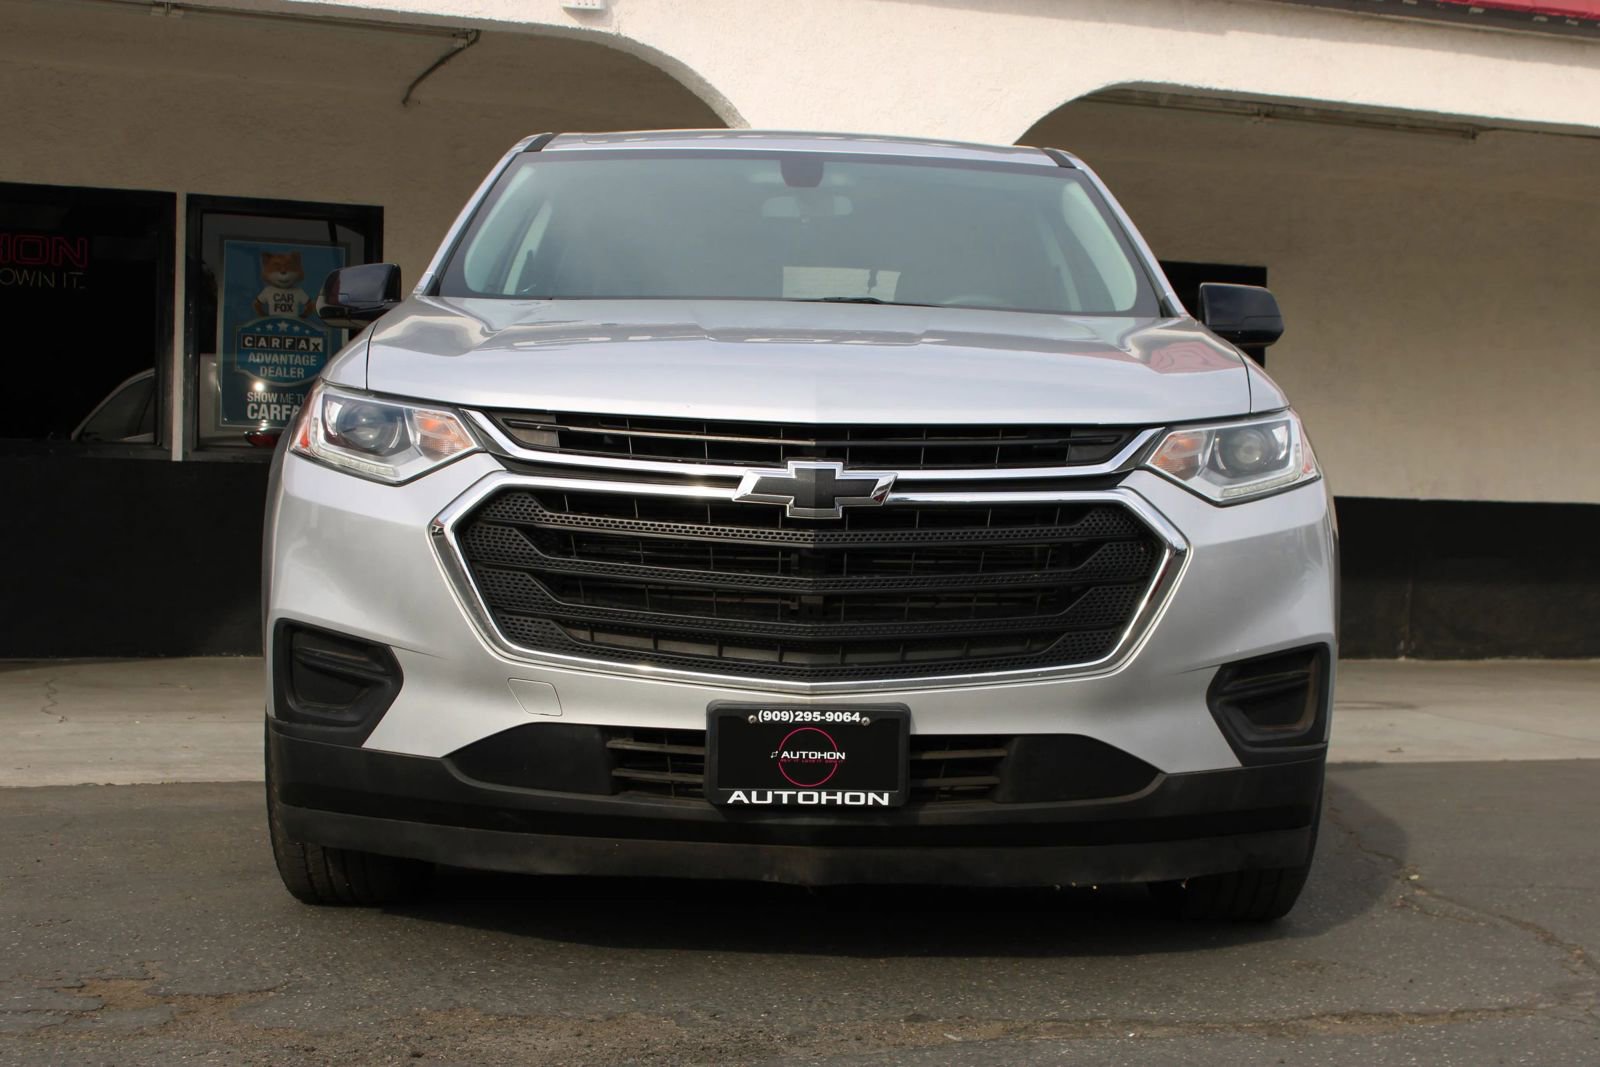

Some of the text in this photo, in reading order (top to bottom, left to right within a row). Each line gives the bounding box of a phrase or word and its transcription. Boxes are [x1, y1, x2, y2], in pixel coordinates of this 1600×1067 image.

[0, 267, 55, 289] OWN
[273, 292, 295, 303] CAR
[274, 303, 294, 313] FOX
[243, 335, 321, 352] CARFAX
[247, 352, 317, 366] ADVANTAGE
[259, 366, 305, 379] DEALER
[246, 391, 278, 403] SHOW
[279, 393, 294, 404] ME
[757, 709, 861, 723] (909)295-9064
[780, 750, 846, 760] AUTOHON
[727, 790, 889, 806] AUTOHON
